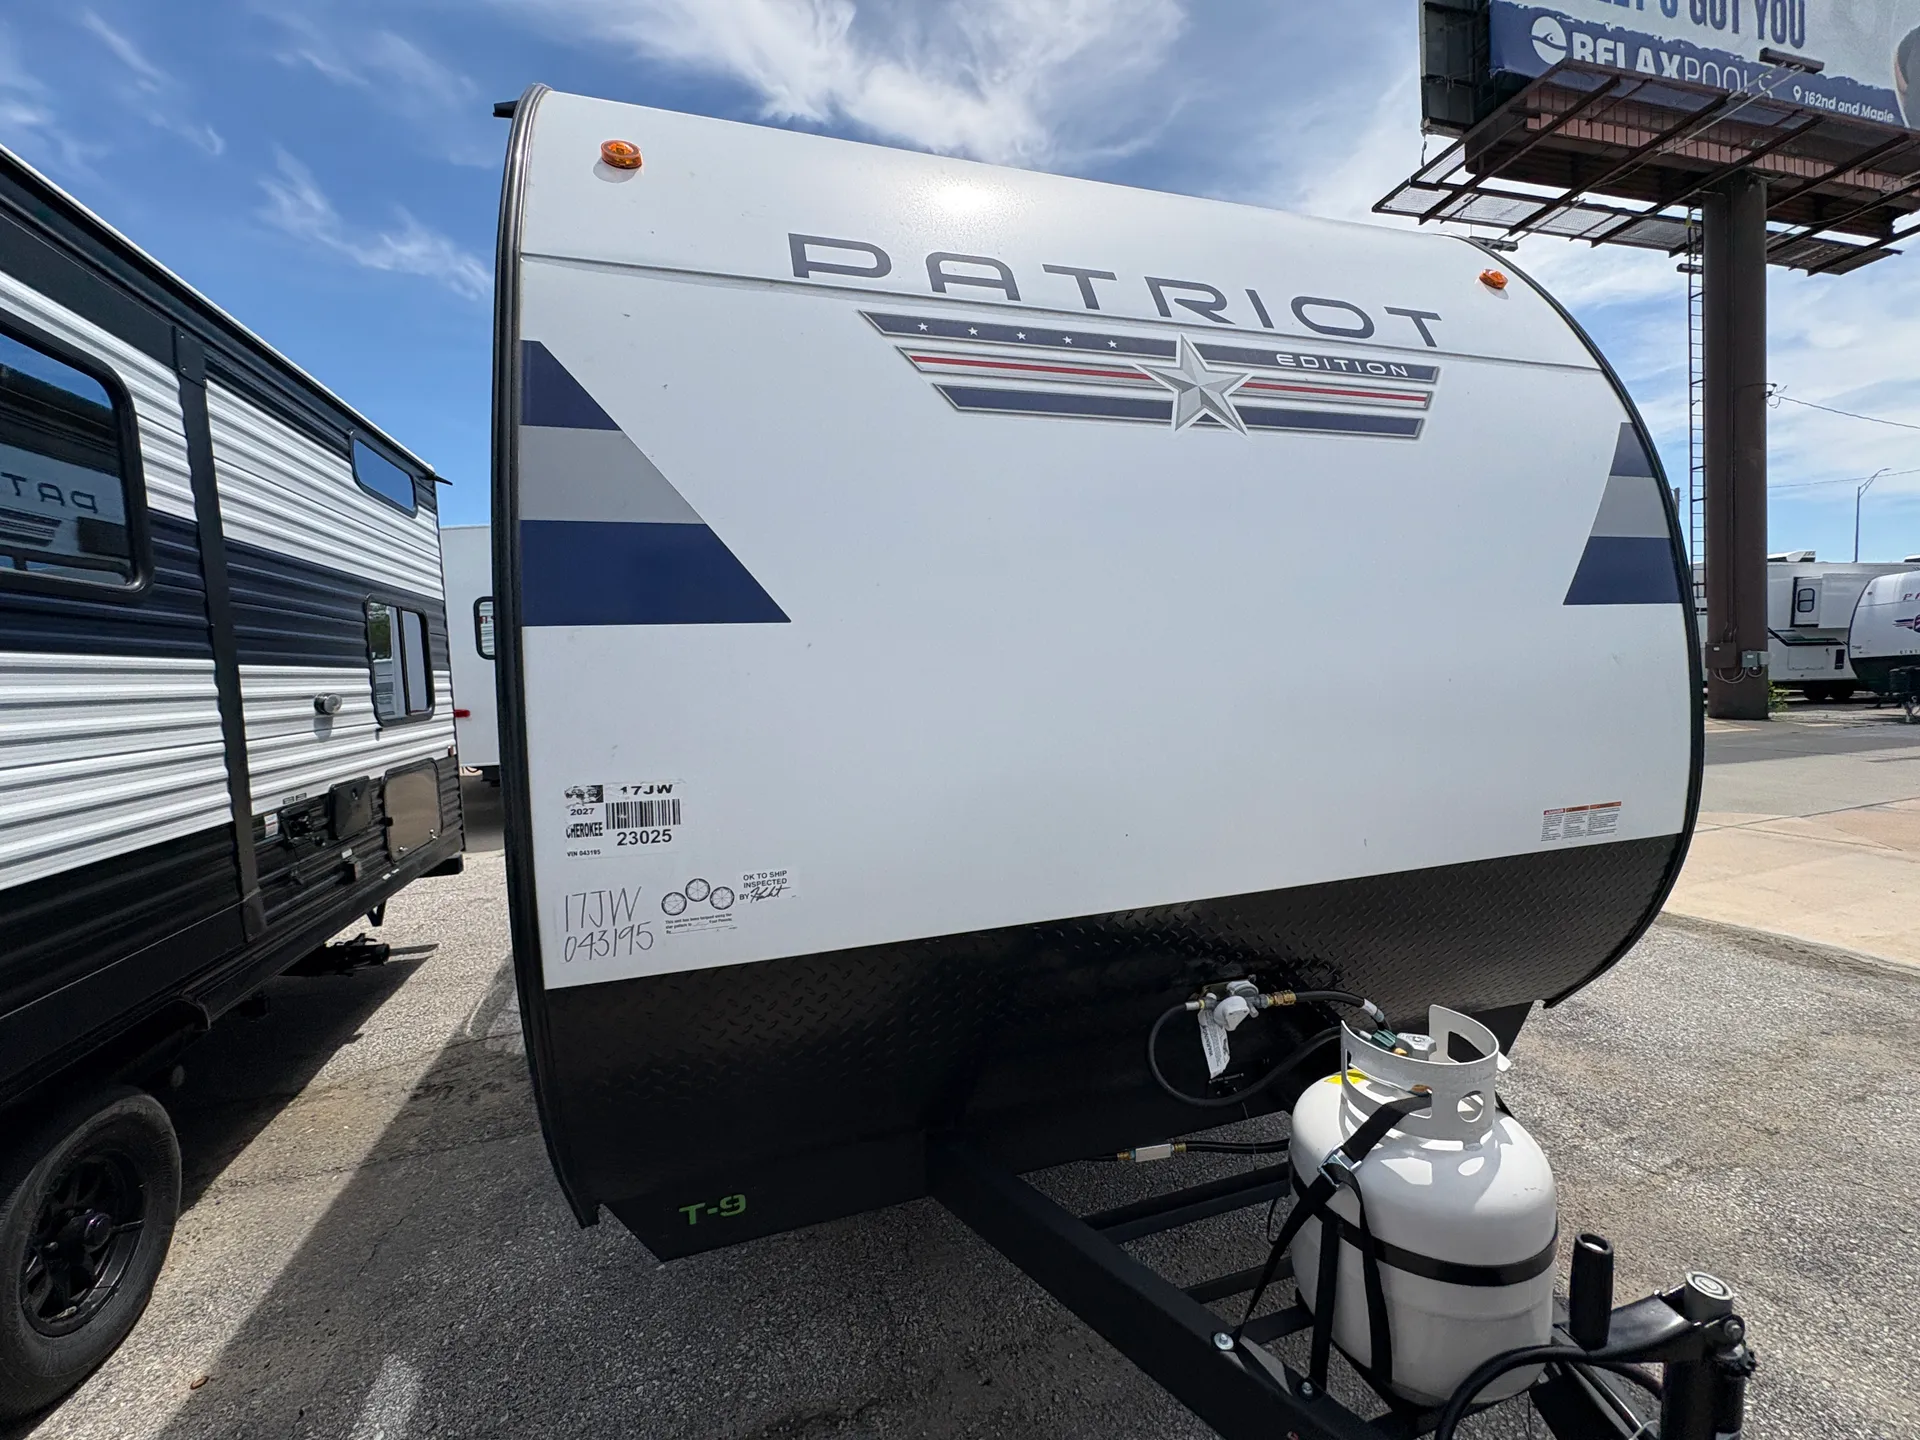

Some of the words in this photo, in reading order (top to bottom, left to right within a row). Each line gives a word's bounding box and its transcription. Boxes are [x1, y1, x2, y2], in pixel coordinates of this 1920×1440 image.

[1804, 91, 1836, 110] 162nd
[1837, 101, 1859, 115] and
[1861, 104, 1894, 123] Maple
[788, 232, 1442, 348] PATRIOT
[1276, 353, 1409, 378] EDITION
[619, 784, 673, 796] 17JW
[570, 807, 595, 816] 2027
[565, 822, 603, 839] CHEROKEE
[616, 829, 672, 846] 23025
[566, 850, 578, 858] VIN
[743, 873, 755, 881] OK
[769, 870, 788, 878] SHIP
[743, 878, 788, 888] INSPECTED
[739, 893, 750, 901] BY
[565, 886, 642, 932] 17JW
[564, 921, 654, 963] 043195
[678, 1193, 747, 1225] T-9
